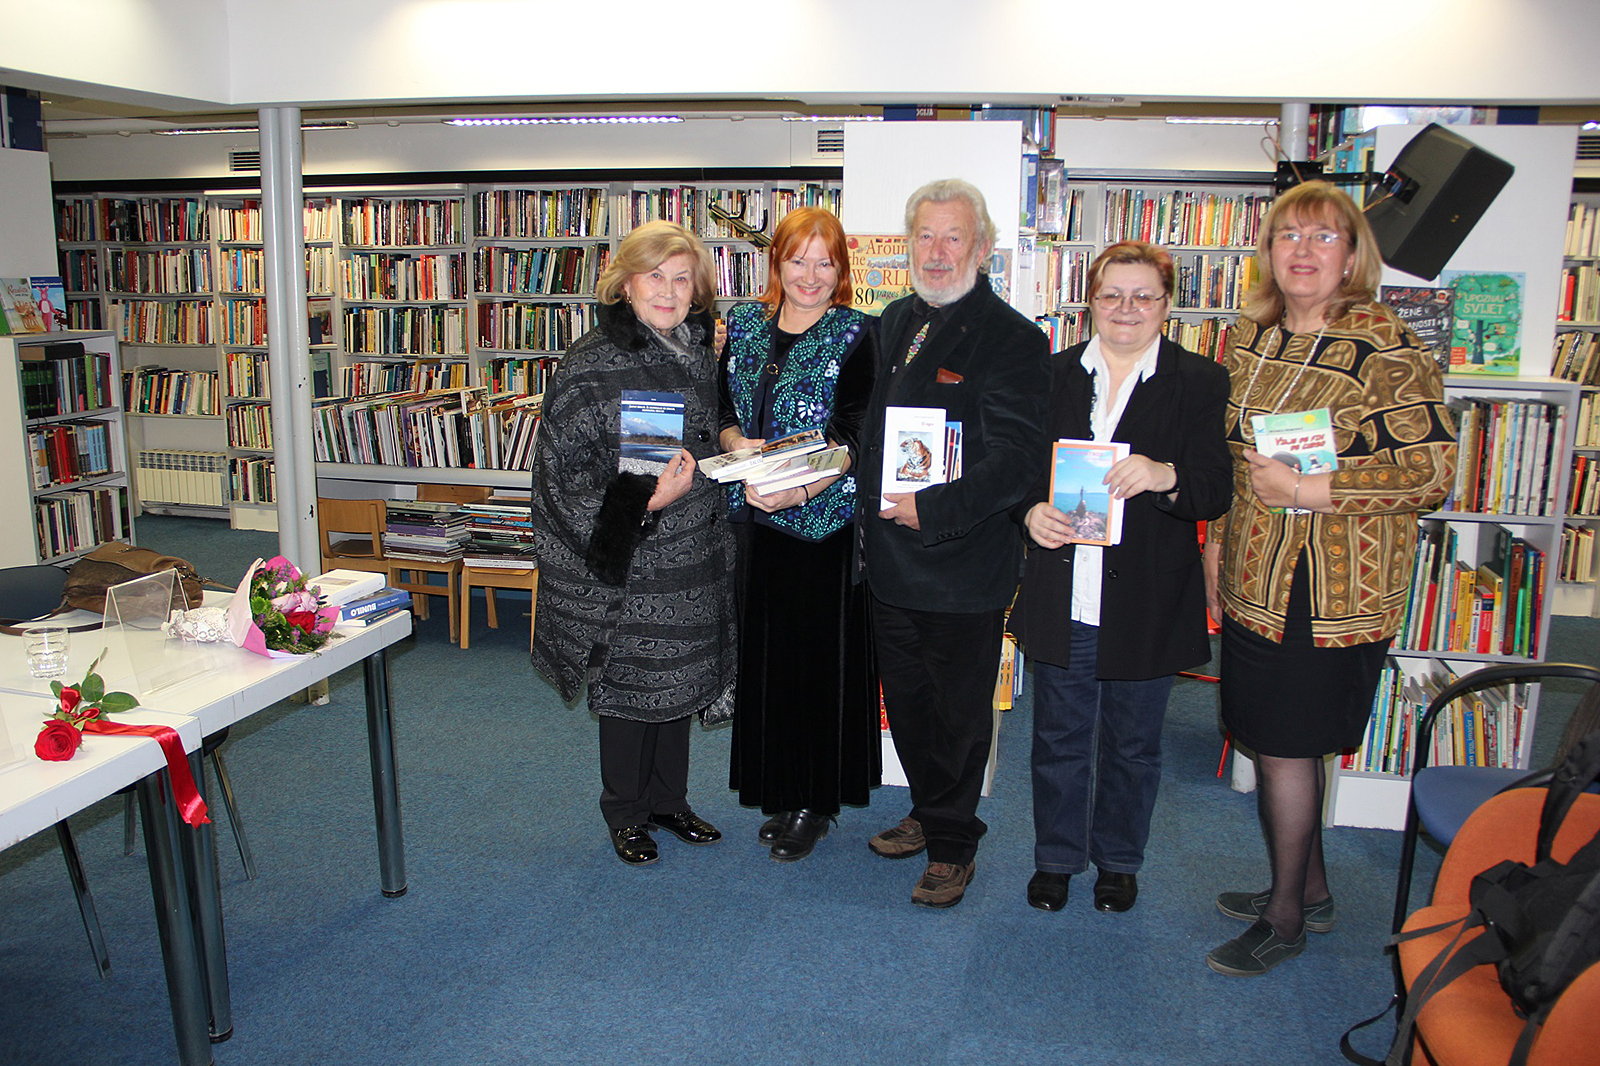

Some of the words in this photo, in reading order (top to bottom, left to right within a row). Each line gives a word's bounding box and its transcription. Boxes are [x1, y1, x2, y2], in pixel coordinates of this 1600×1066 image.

[866, 239, 908, 255] Aroun
[849, 251, 865, 266] he
[855, 287, 875, 306] 80
[876, 289, 900, 301] pages
[1462, 303, 1505, 314] SVIJET
[351, 602, 377, 617] BUNILO
